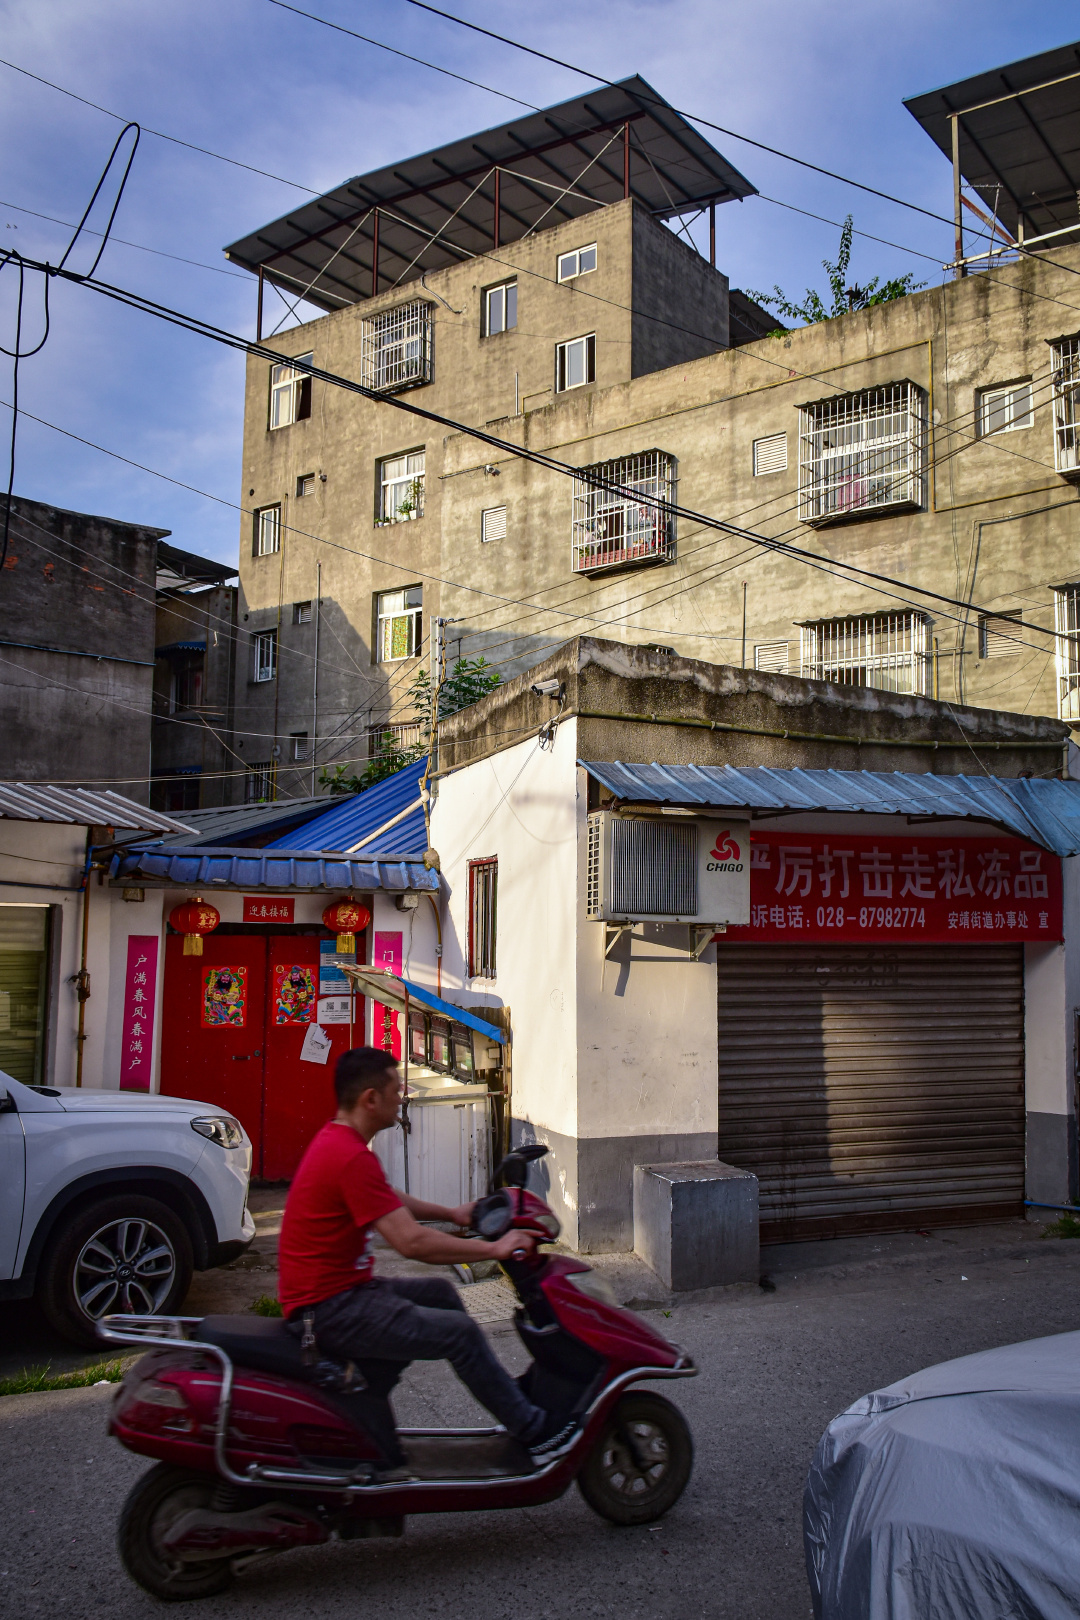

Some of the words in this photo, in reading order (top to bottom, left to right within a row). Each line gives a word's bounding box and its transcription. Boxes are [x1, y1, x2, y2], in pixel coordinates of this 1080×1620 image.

[706, 862, 744, 873] CHIGO
[249, 904, 289, 918] 迎春接福
[948, 910, 1029, 930] 安靖街道办事处
[1038, 910, 1049, 930] 宣
[128, 953, 148, 1071] 户满春风春满户
